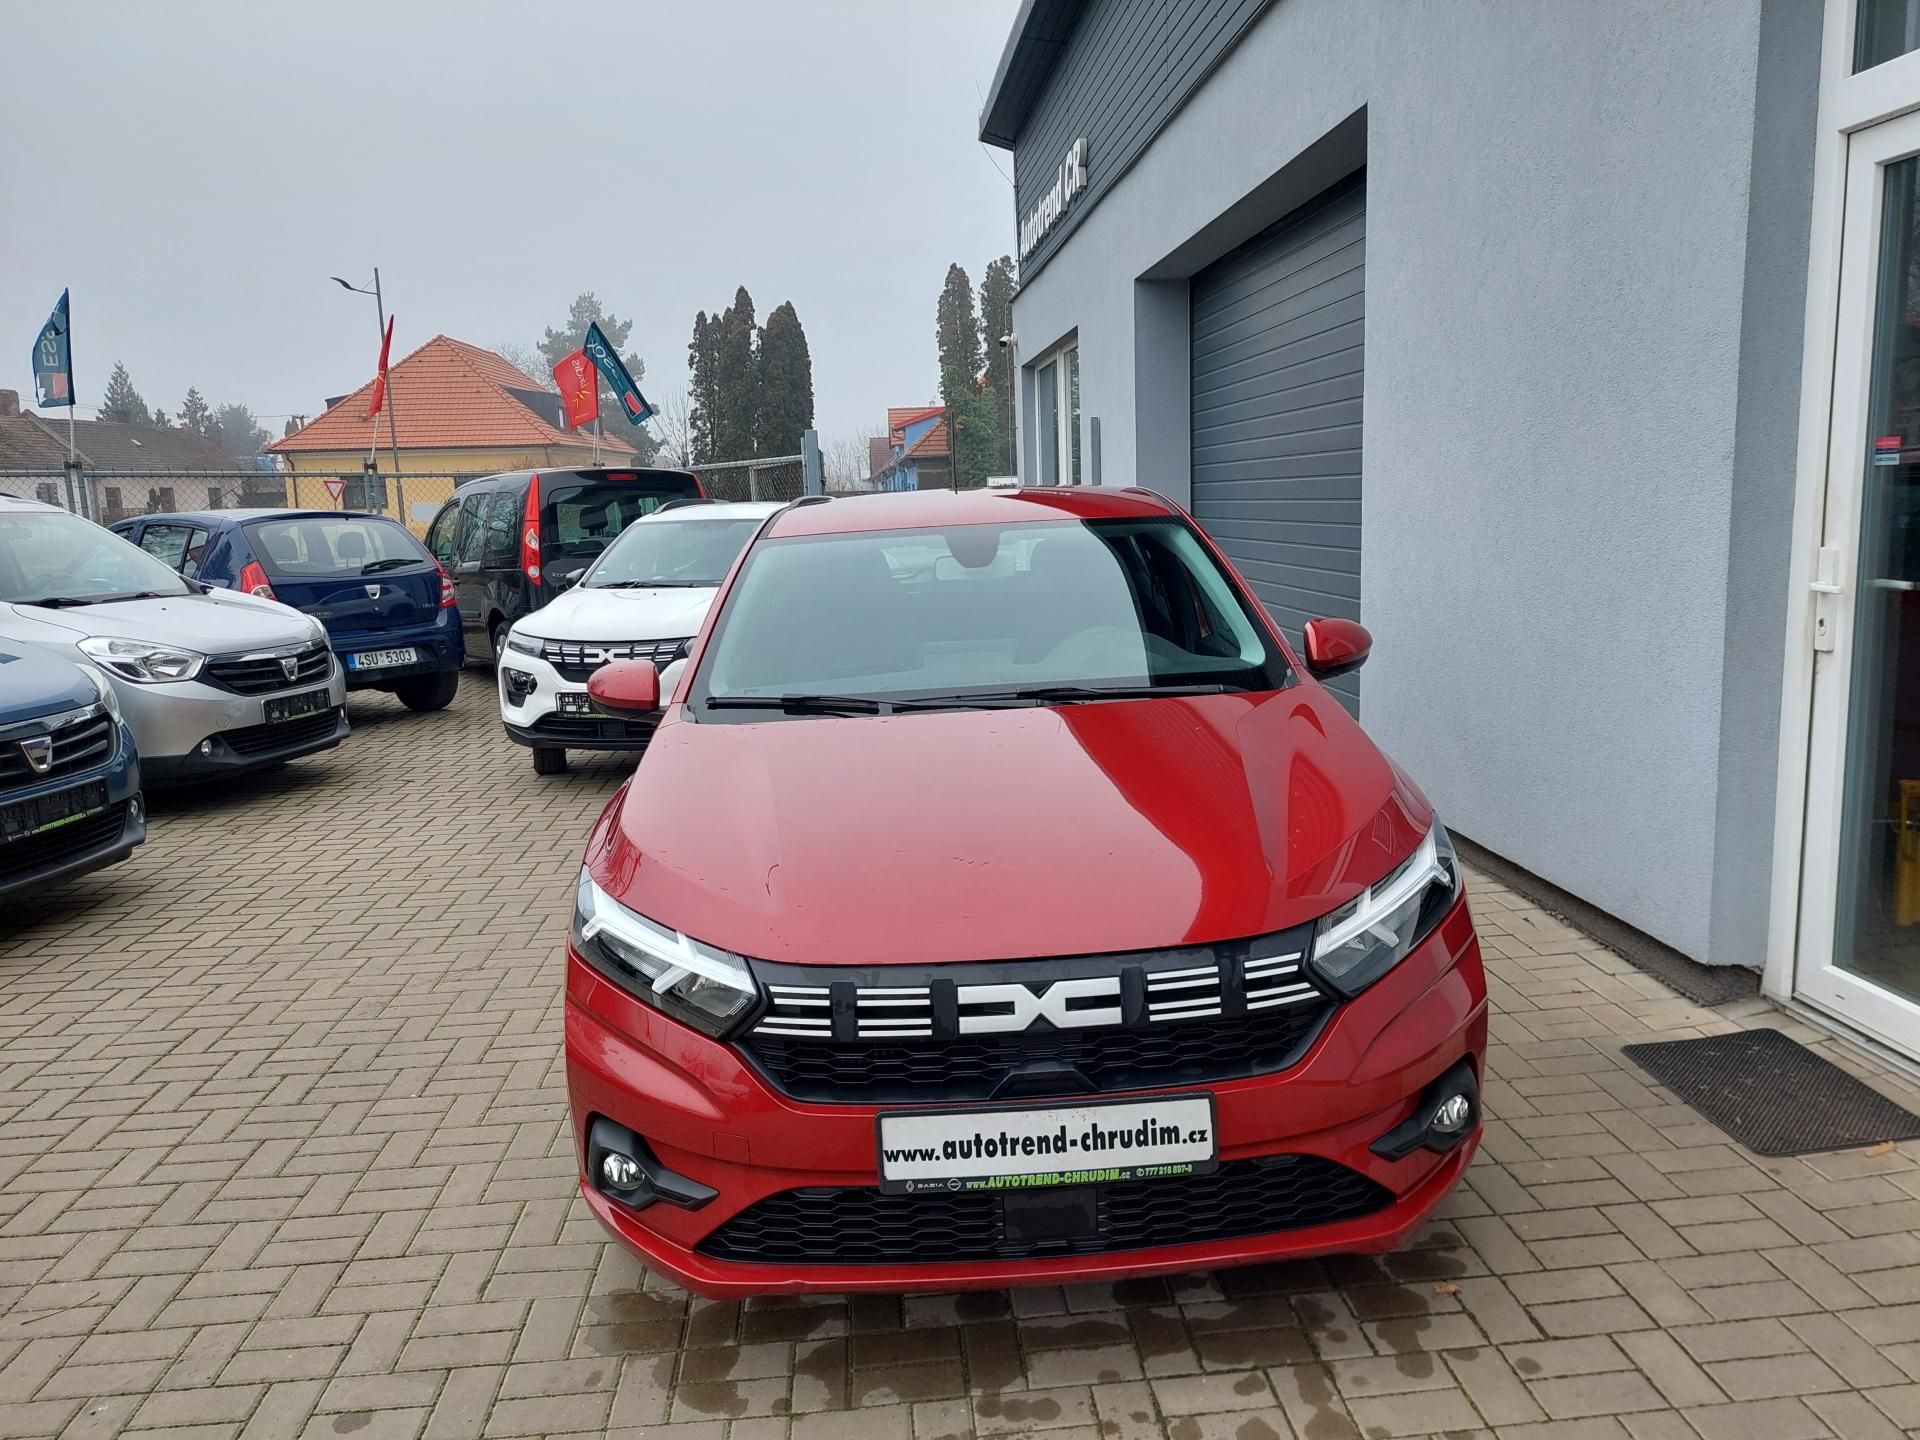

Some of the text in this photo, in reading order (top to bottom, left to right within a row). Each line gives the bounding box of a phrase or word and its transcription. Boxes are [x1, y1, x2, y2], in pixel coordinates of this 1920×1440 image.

[1020, 138, 1083, 262] Autotrend CR
[358, 653, 379, 667] 4SU
[386, 649, 412, 663] 5303
[883, 1117, 1208, 1163] www.autotrend-chrudim.cz
[965, 1168, 1131, 1189] www.AUTOTREND-CHRUDIM.cz
